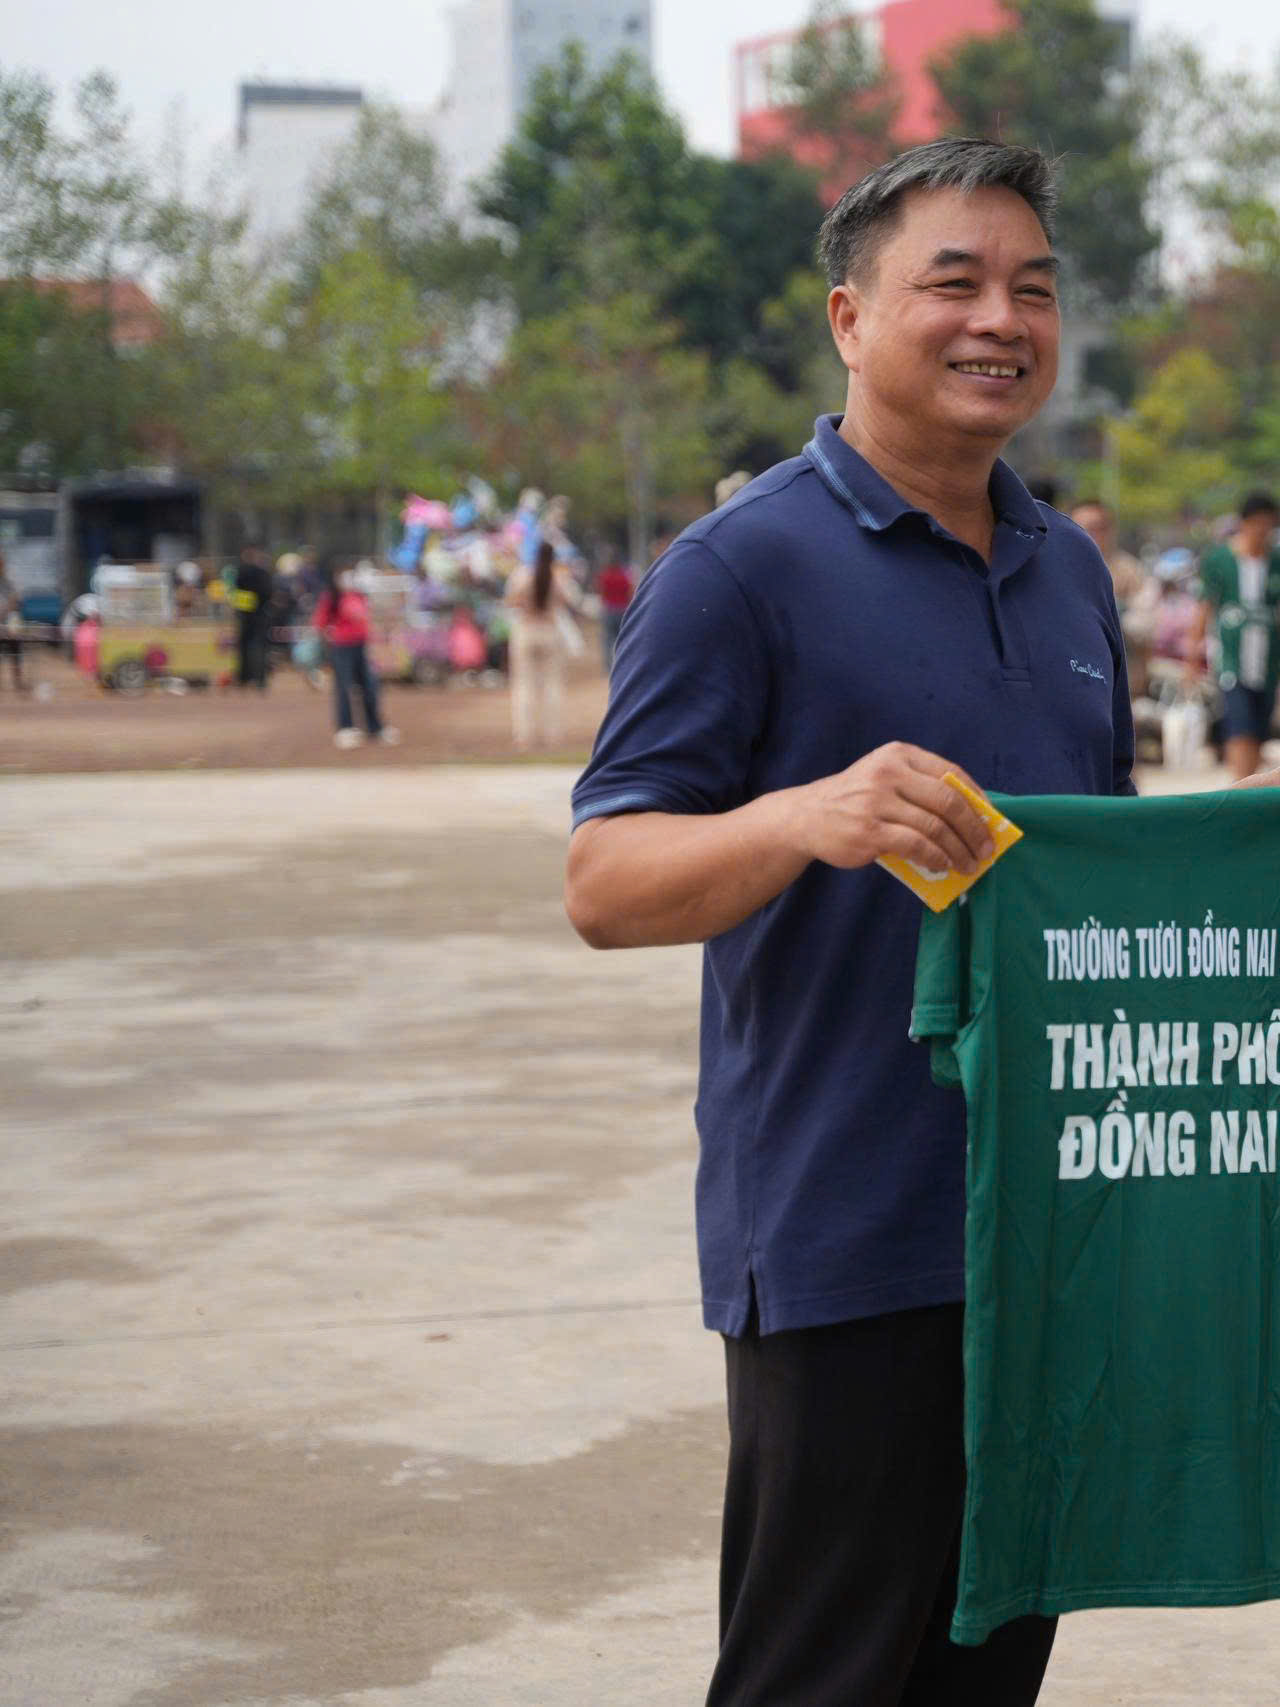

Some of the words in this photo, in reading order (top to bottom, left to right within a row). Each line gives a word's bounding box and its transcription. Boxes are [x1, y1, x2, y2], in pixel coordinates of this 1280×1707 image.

[1043, 916, 1131, 981] TRƯỜNG
[1135, 920, 1183, 979] TƯƠI
[1187, 909, 1240, 978] ĐỒNG
[1246, 928, 1277, 977] NAI
[1046, 1008, 1200, 1090] THÀNH
[1058, 1090, 1196, 1180] ĐỒNG
[1209, 1110, 1278, 1175] NAI
